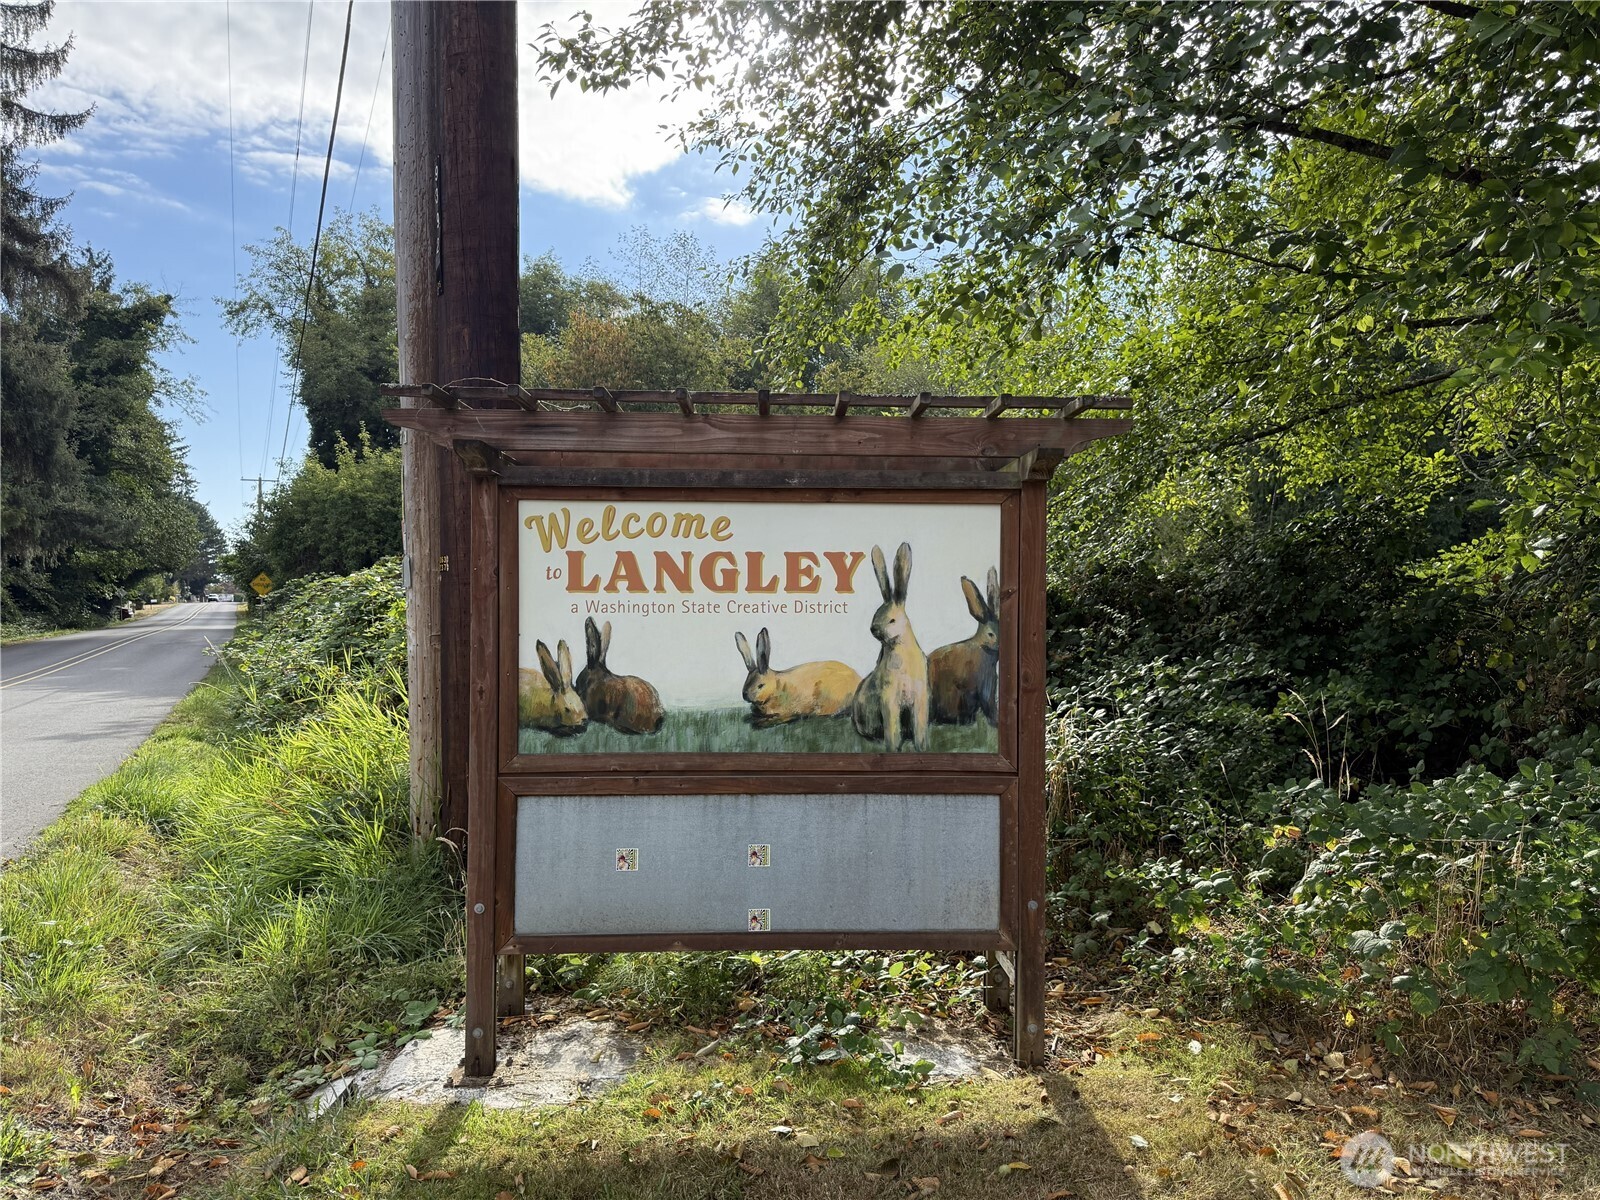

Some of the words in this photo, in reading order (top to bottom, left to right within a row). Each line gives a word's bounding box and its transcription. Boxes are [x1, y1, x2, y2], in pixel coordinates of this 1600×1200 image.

[524, 505, 734, 553] Welcome
[546, 565, 562, 581] to
[565, 550, 866, 594] LANGLEY
[571, 604, 579, 614] a
[585, 600, 675, 618] Washington
[682, 600, 721, 614] State
[726, 600, 788, 614] Creative
[794, 600, 848, 614] District
